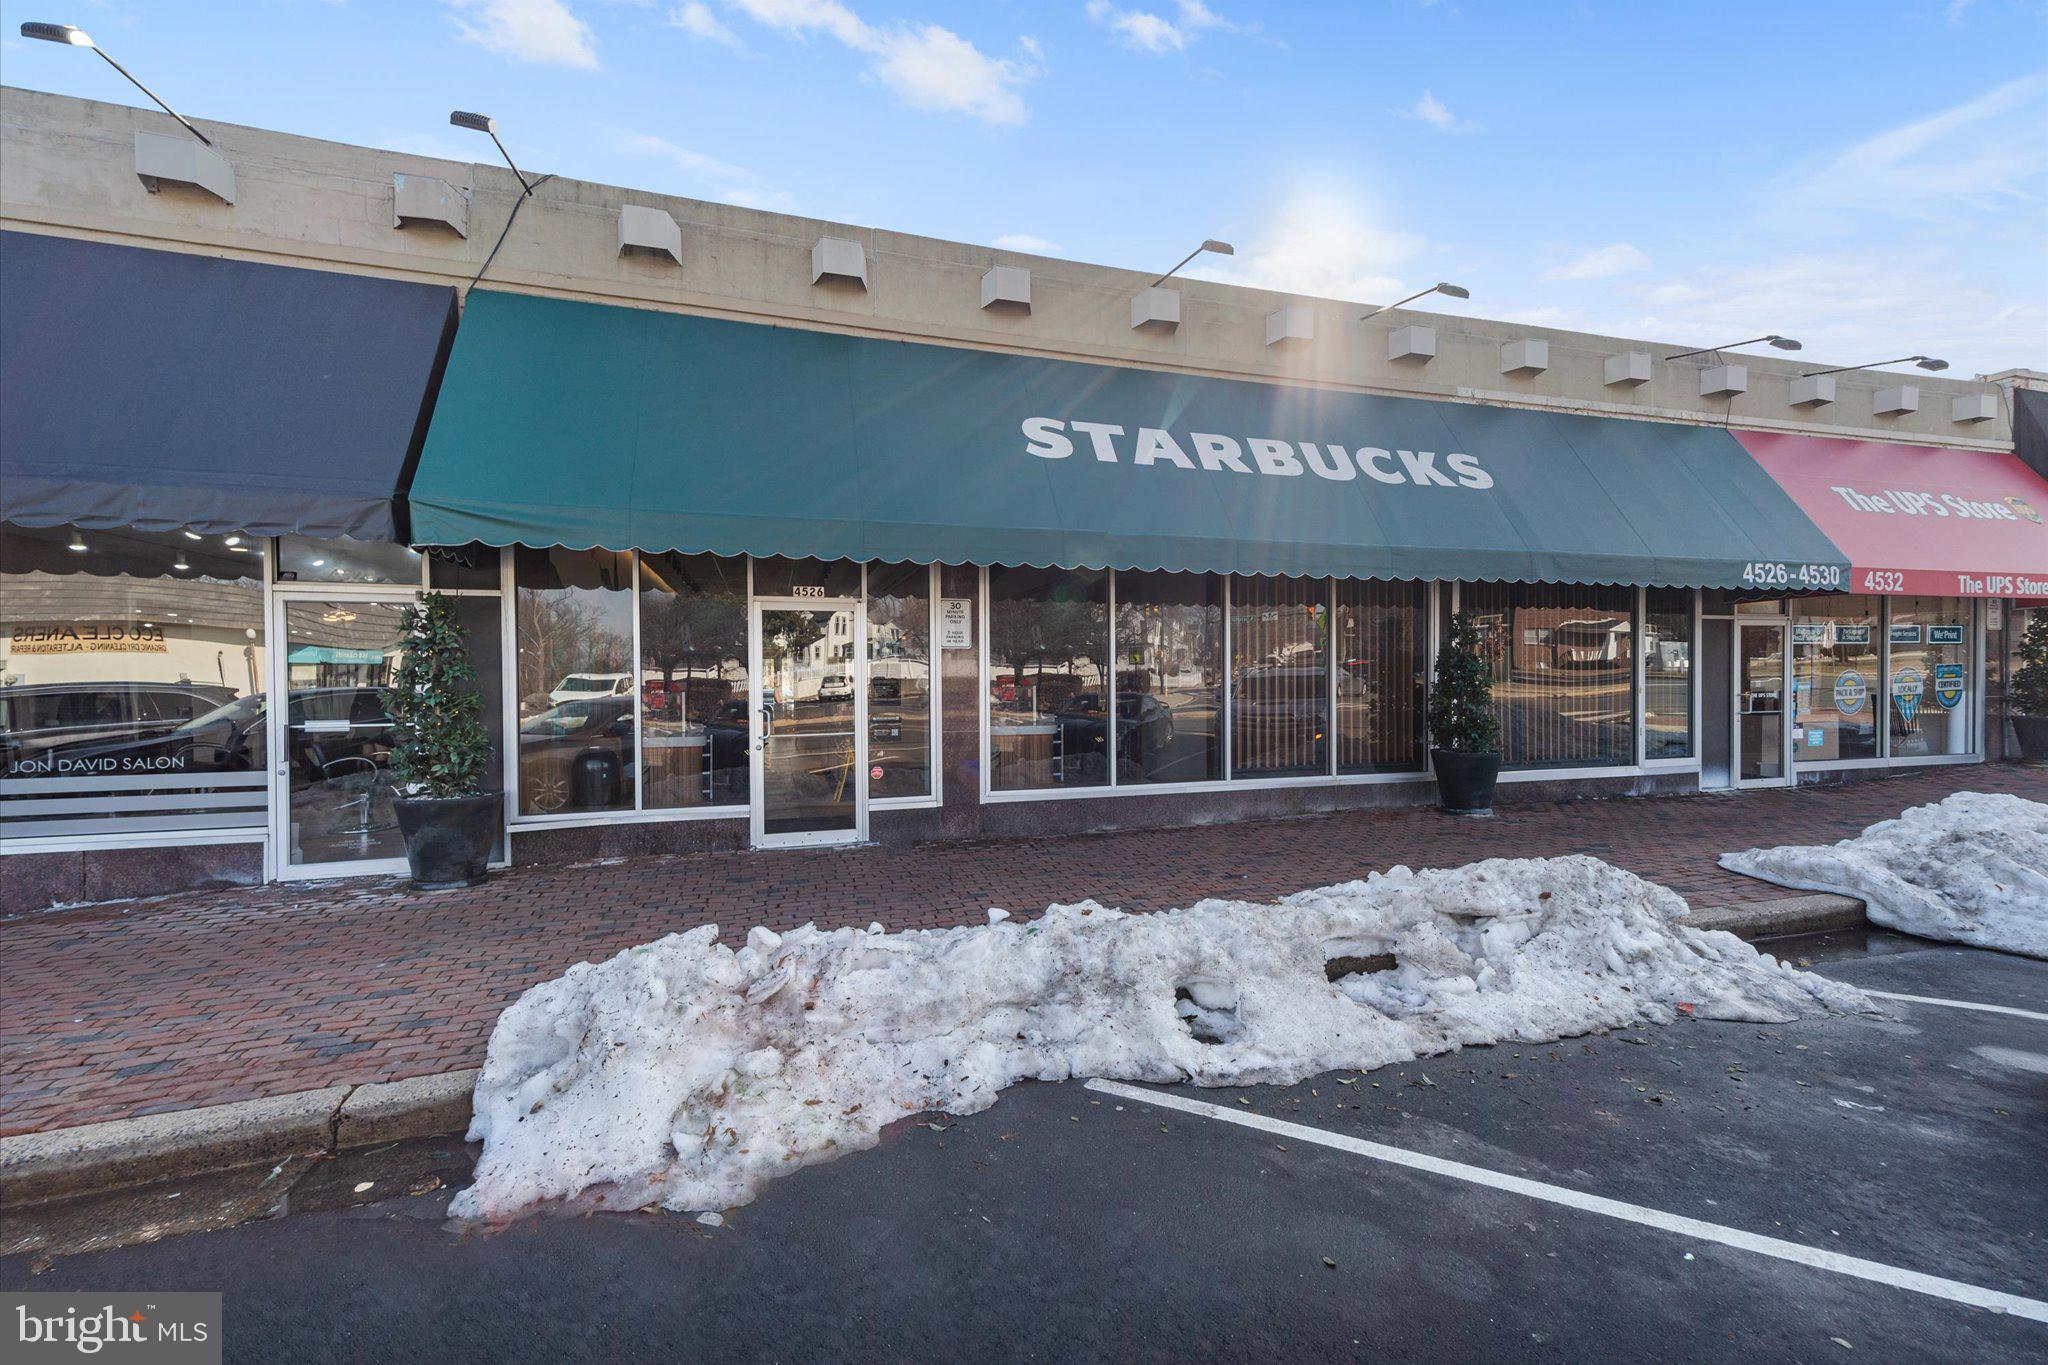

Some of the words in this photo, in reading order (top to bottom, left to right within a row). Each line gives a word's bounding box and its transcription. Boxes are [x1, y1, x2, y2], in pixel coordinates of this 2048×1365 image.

[1021, 416, 1495, 490] STARBUCKS
[1830, 486, 1895, 514] The
[1883, 490, 1949, 517] UPS
[1940, 494, 2019, 521] Store
[1864, 571, 1904, 592] 4532
[1958, 575, 1983, 594] The
[1986, 576, 2014, 595] UPS
[2016, 577, 2048, 595] Store
[794, 587, 824, 597] 4526
[950, 602, 961, 610] 30
[10, 760, 52, 774] JON
[58, 758, 118, 772] DAVID
[122, 756, 185, 770] SALON
